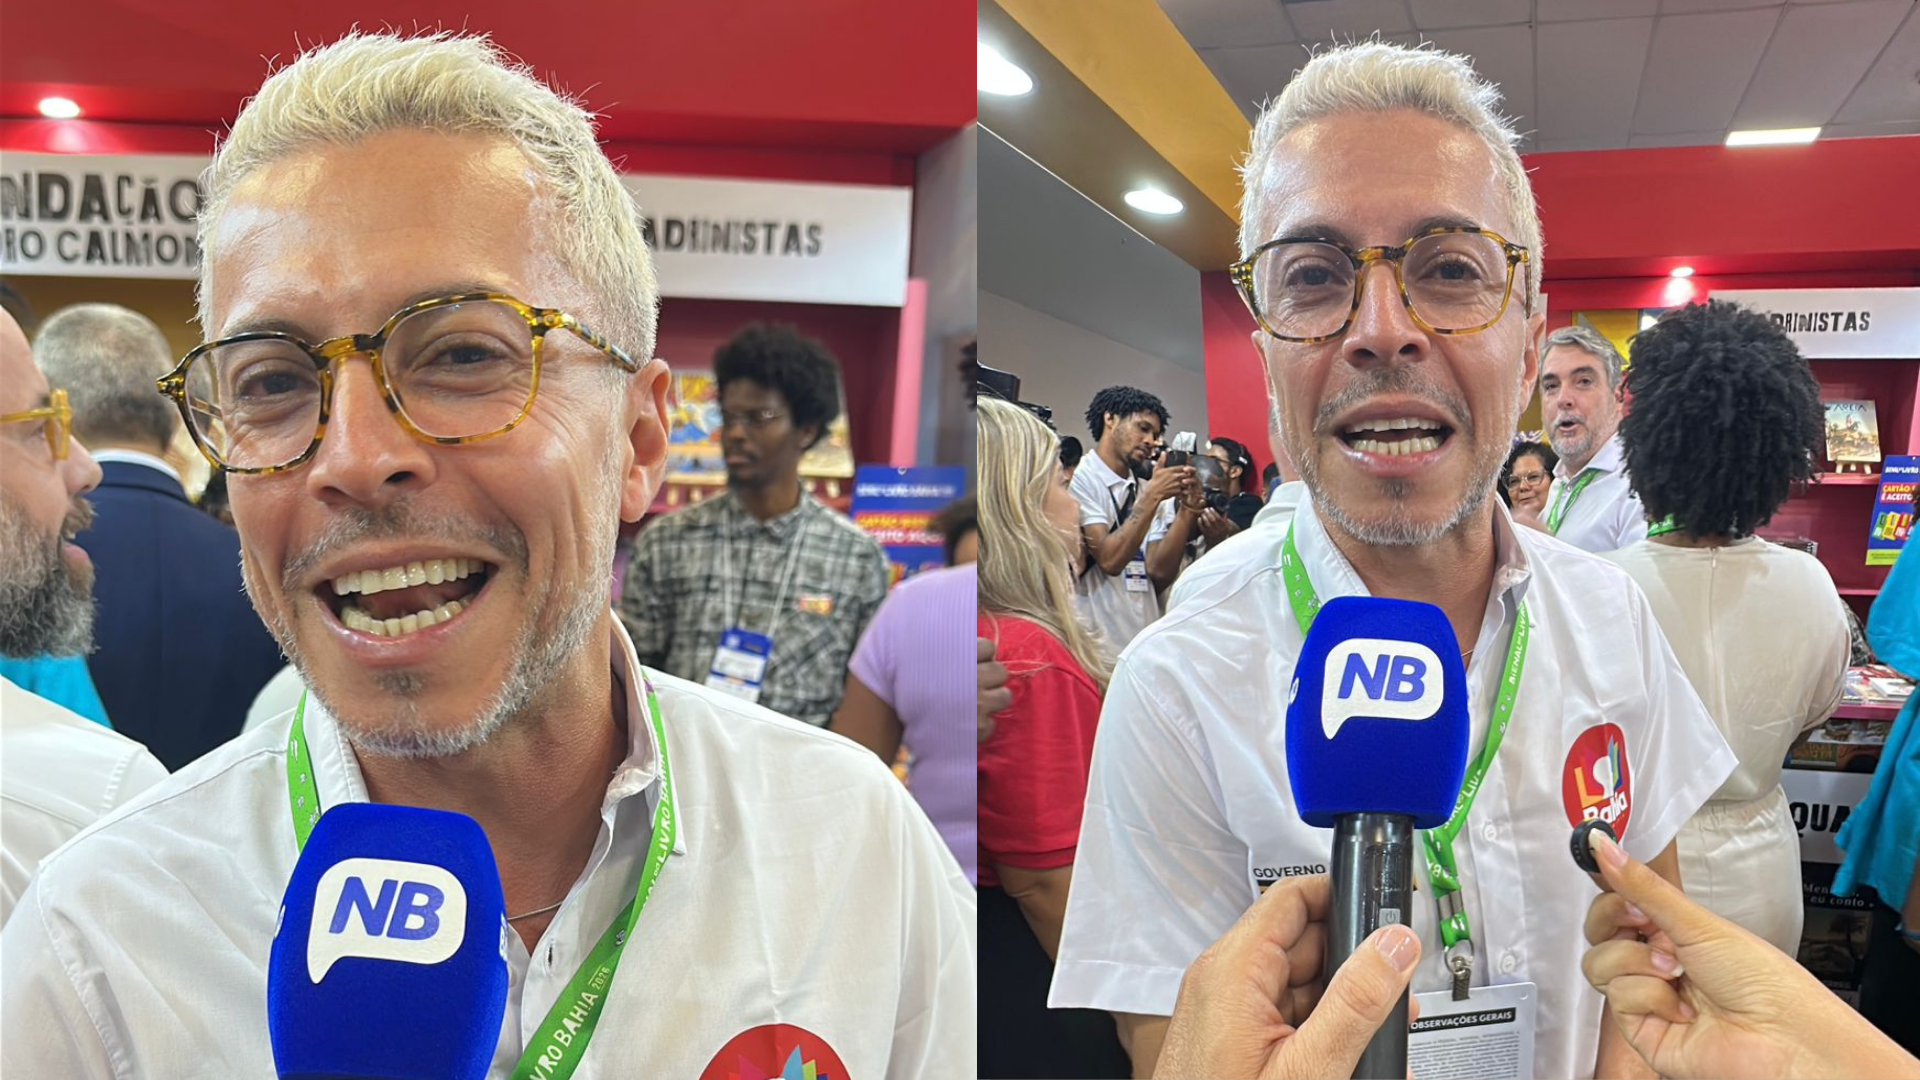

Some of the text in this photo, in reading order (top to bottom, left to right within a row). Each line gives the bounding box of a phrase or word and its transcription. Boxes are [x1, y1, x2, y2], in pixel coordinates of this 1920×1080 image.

[1338, 653, 1427, 702] NB
[659, 808, 671, 864] LIVRO
[1253, 864, 1326, 879] GOVERNO
[328, 876, 445, 941] NB
[591, 966, 611, 990] 2026
[1410, 1010, 1513, 1030] OBSERVAÇÕES GERAIS
